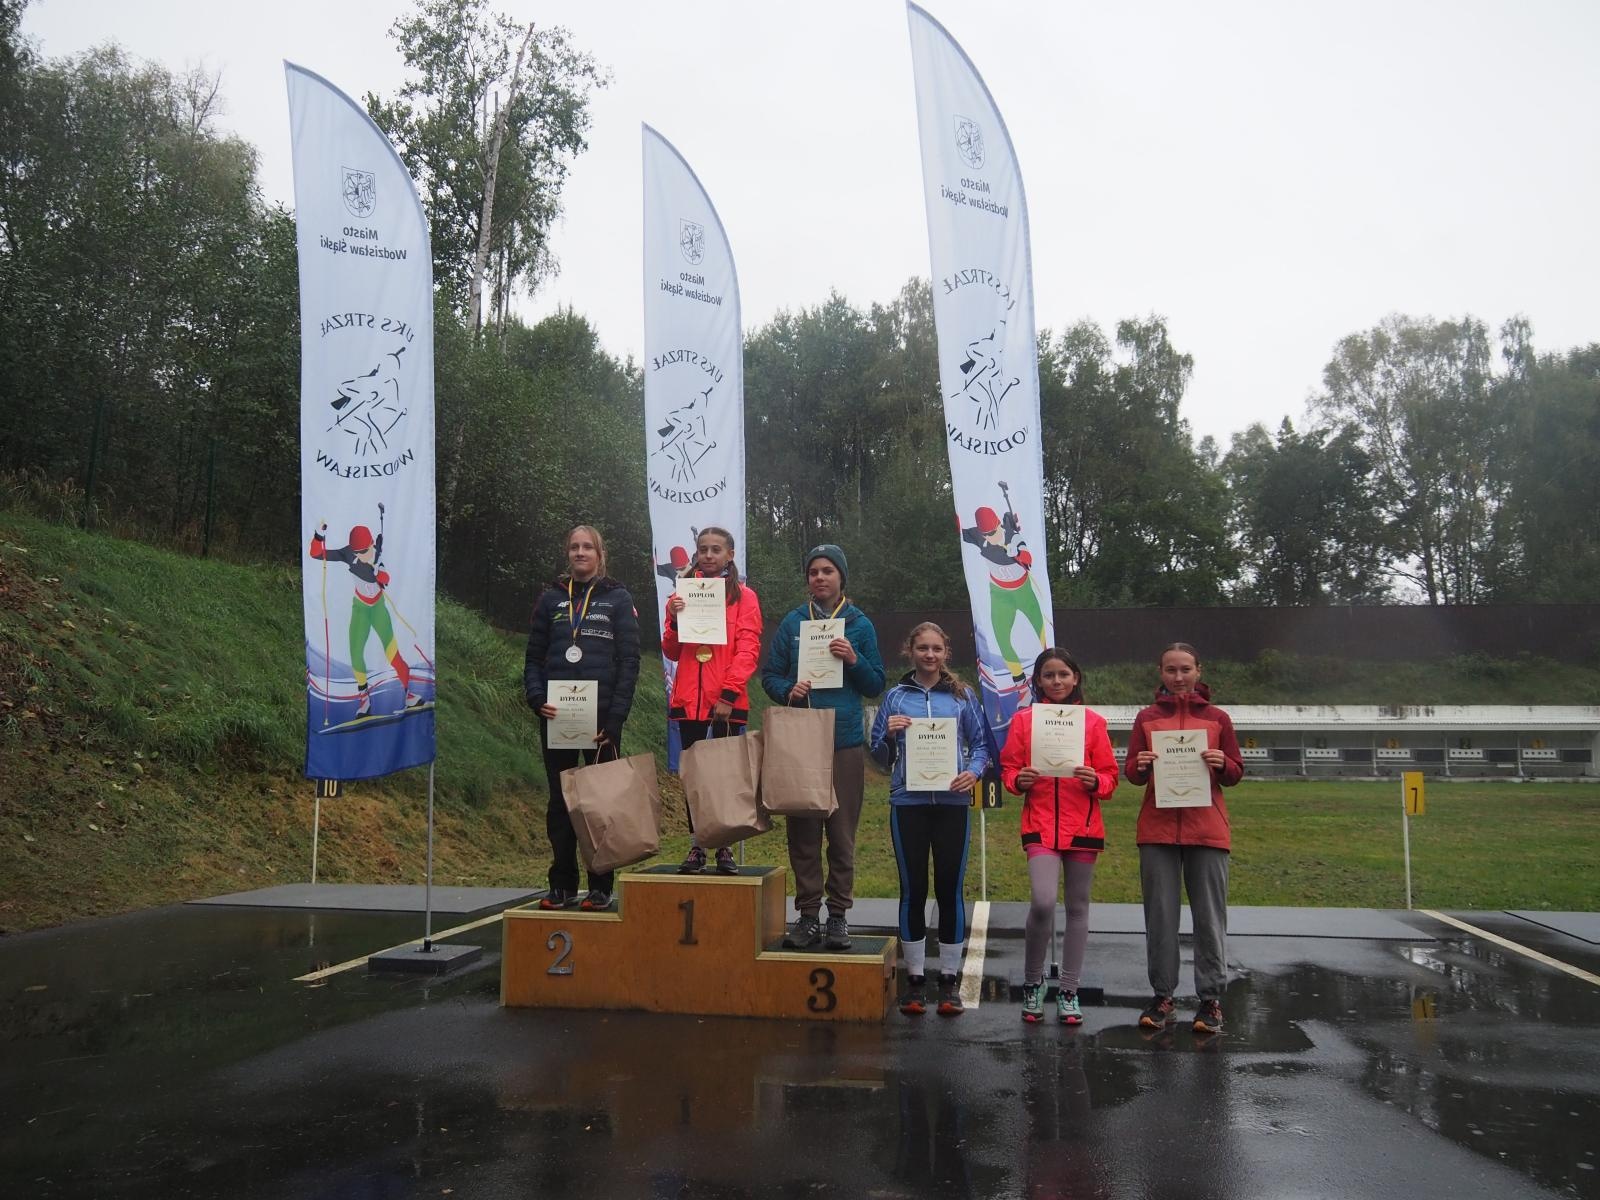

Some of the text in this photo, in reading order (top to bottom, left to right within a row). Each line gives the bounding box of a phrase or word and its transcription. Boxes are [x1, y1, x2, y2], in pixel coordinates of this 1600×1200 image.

[324, 779, 338, 797] 10
[988, 782, 996, 807] 8
[677, 899, 699, 946] 1
[546, 929, 575, 976] 2
[807, 967, 837, 1013] 3
